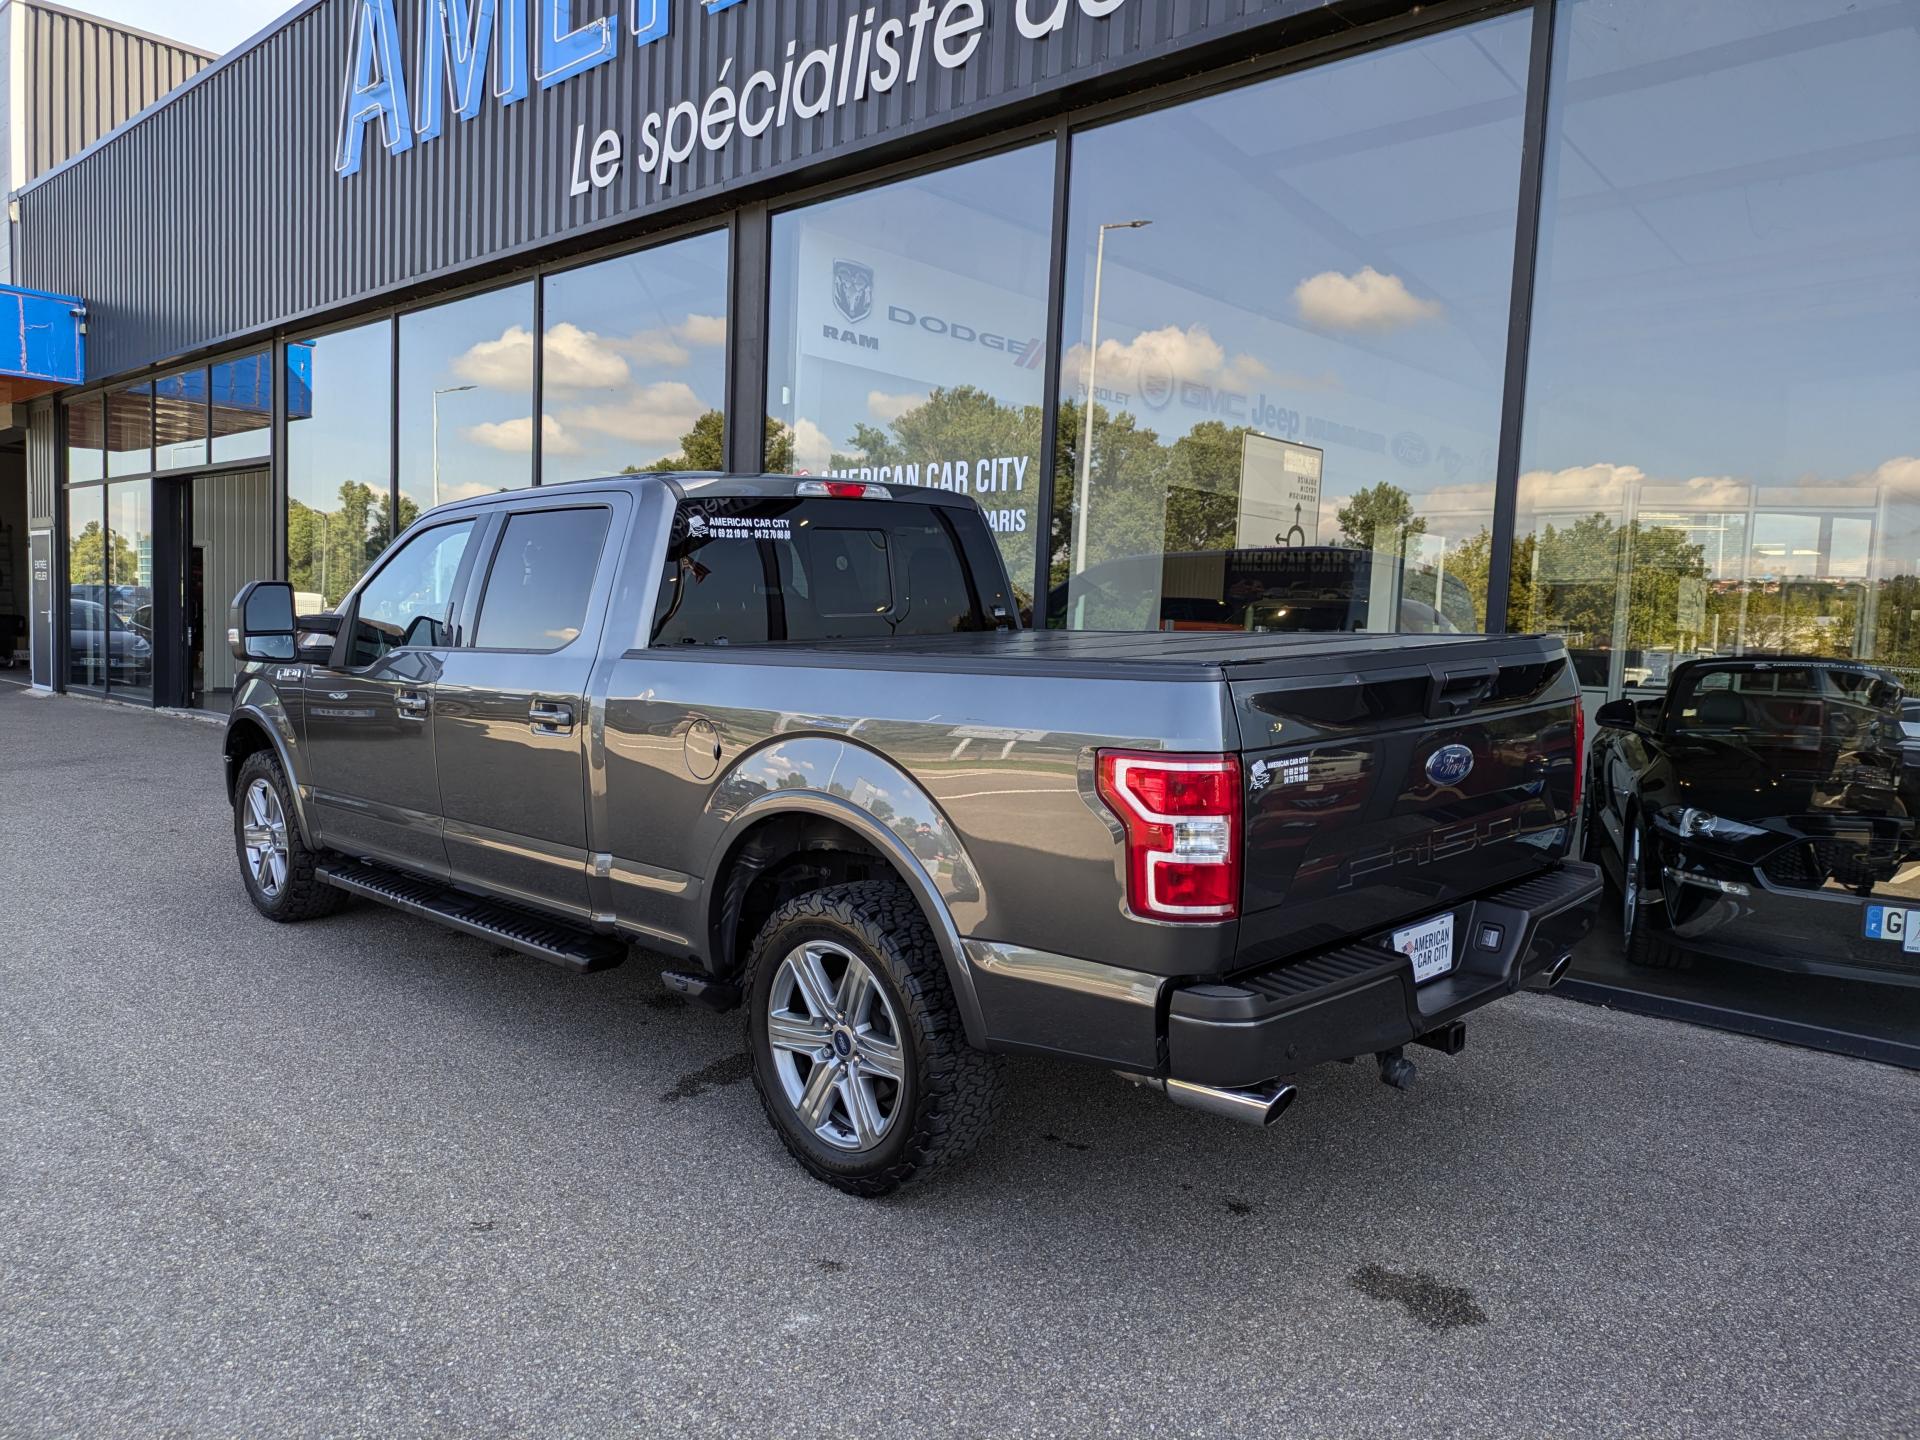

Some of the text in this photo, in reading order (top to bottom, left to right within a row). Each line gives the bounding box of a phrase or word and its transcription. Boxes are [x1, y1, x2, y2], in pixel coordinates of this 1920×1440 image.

[570, 0, 984, 197] Le spécialiste
[823, 324, 878, 351] RAM
[888, 305, 1029, 356] DODGE
[1180, 380, 1247, 421] GMC
[1252, 394, 1299, 439] Jeep
[926, 460, 968, 493] CAR
[976, 455, 1029, 493] CITY
[709, 517, 790, 528] AMERICAN CAR CITY
[709, 528, 717, 538] 01
[726, 529, 734, 538] 22
[754, 529, 762, 539] 04
[762, 530, 769, 539] 72
[769, 530, 777, 539] 70
[1267, 756, 1309, 769] AMERICAN CAR CITY
[1414, 927, 1450, 953] AMERICAN
[1417, 943, 1449, 968] CAR CITY
